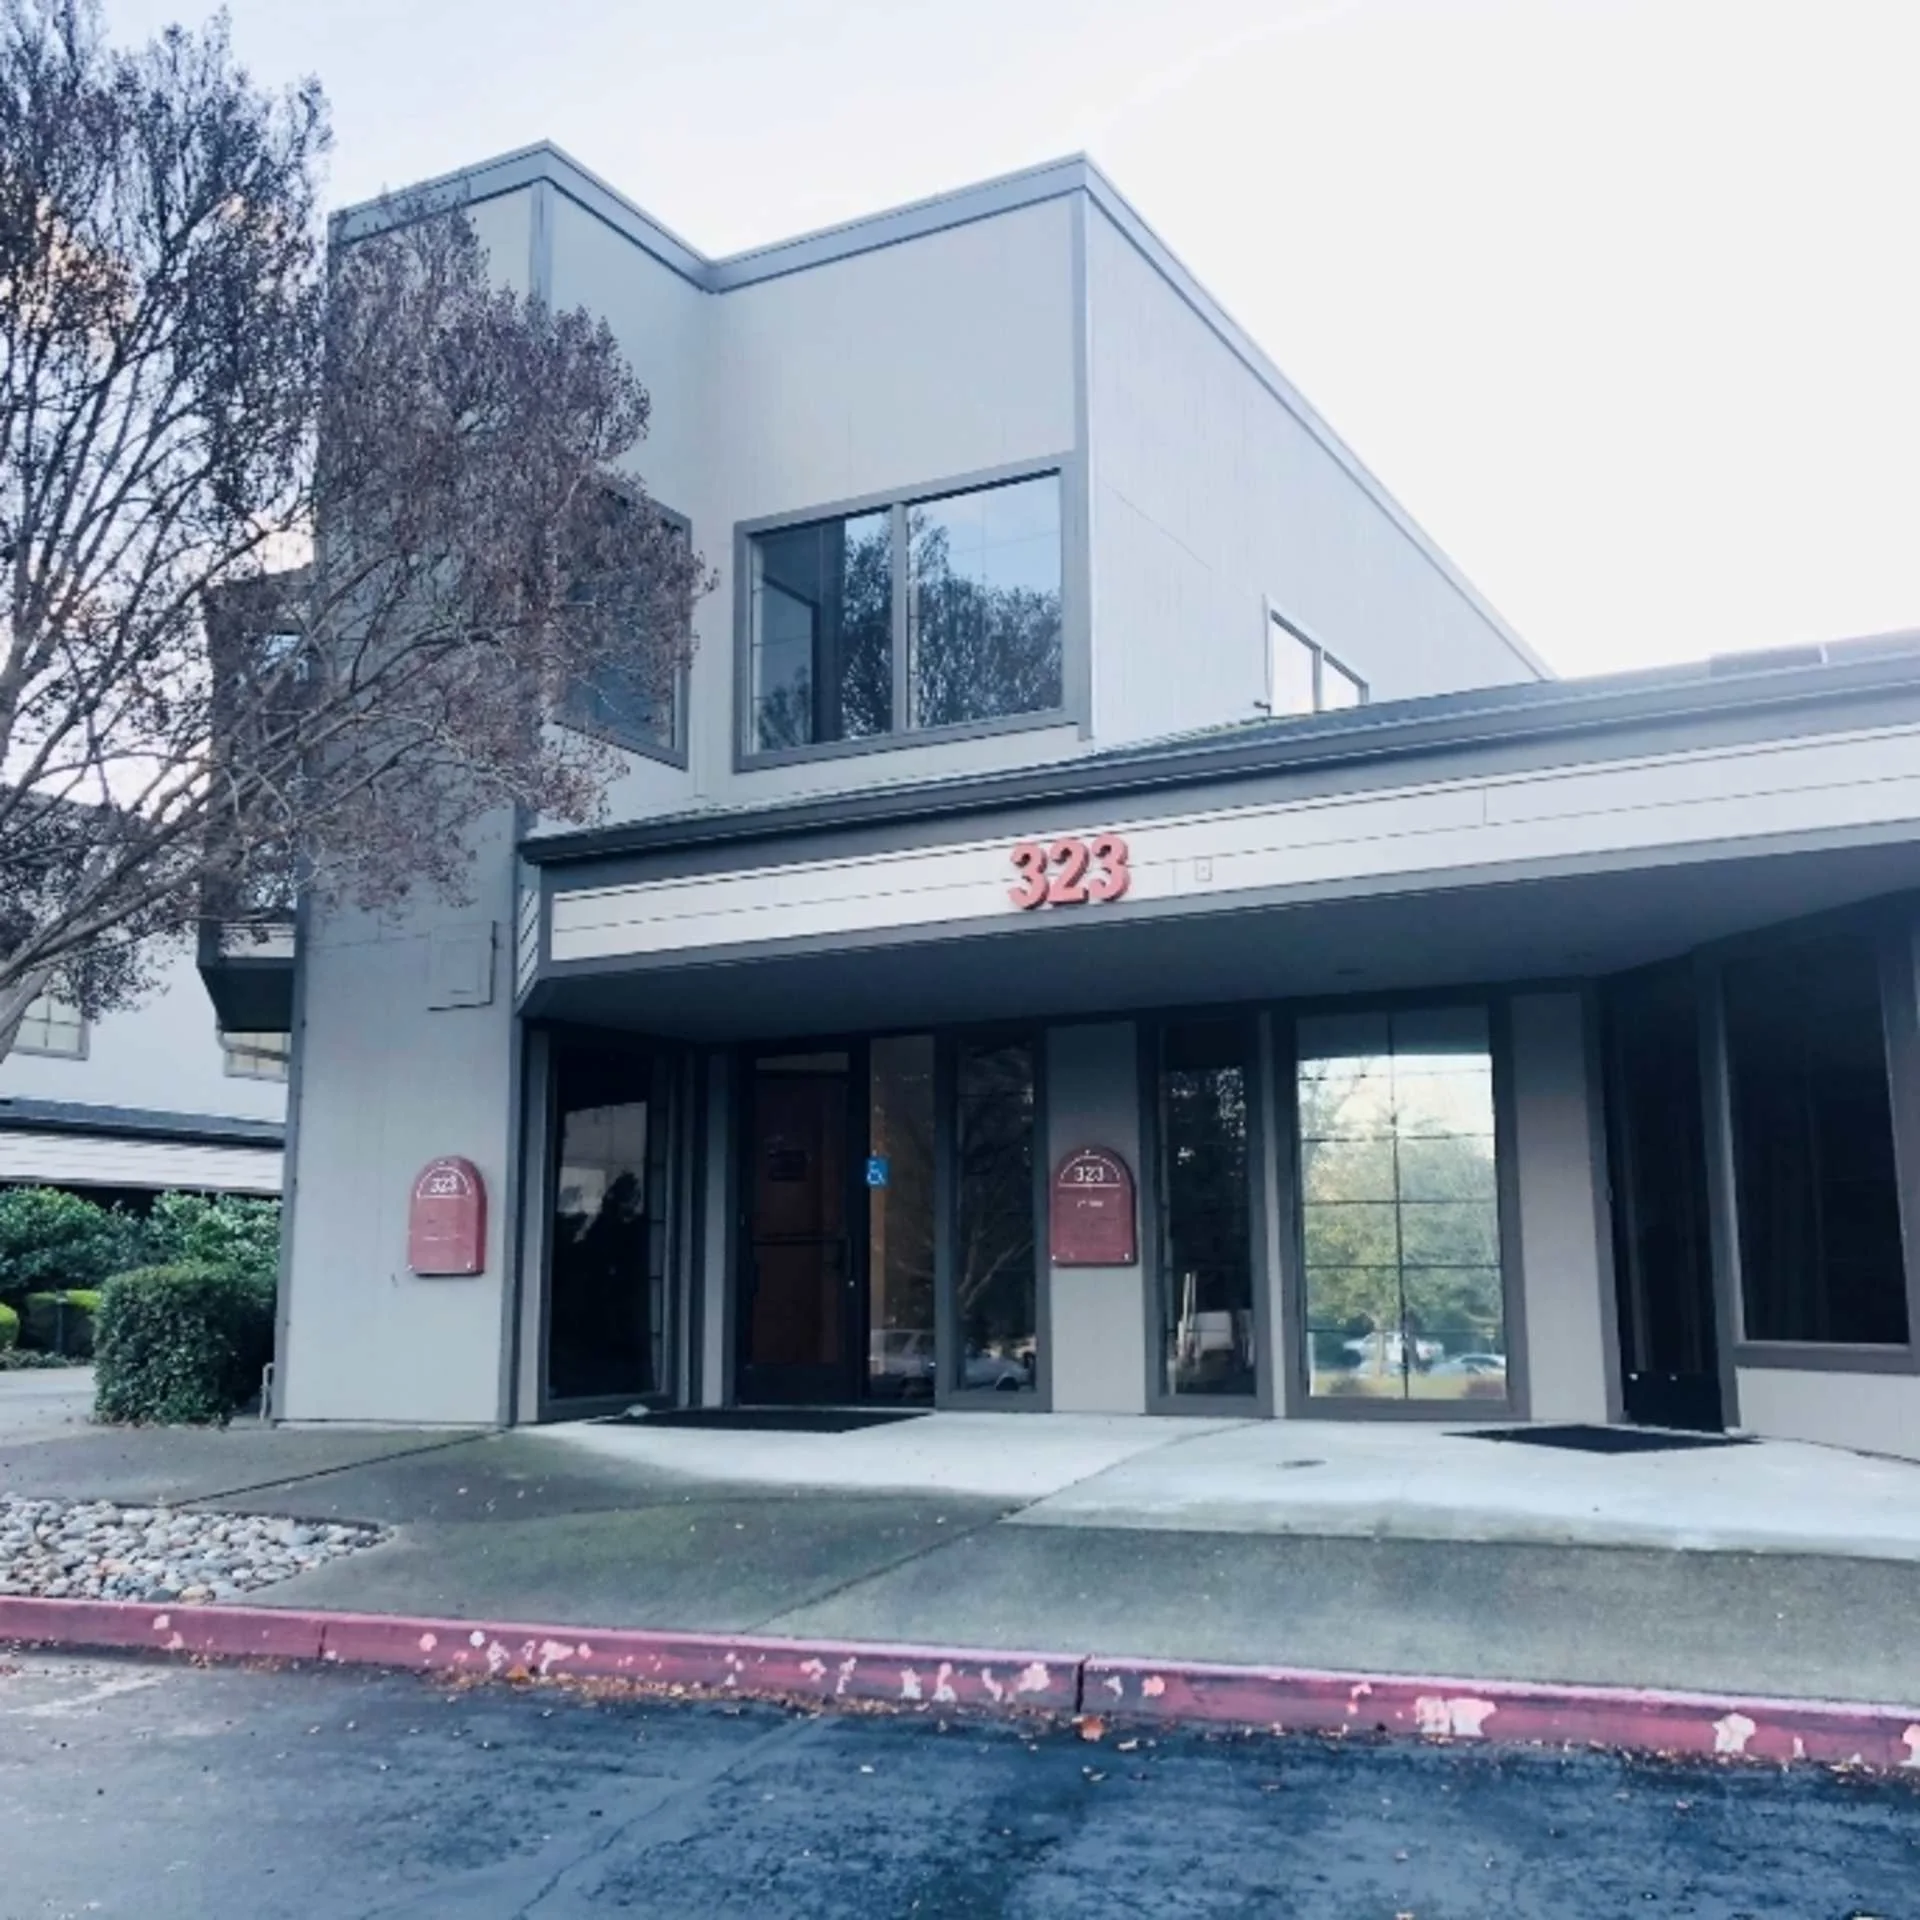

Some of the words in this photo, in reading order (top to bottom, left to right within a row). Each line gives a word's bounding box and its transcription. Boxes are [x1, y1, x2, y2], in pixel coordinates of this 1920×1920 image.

[1008, 834, 1130, 909] 323
[1074, 1166, 1104, 1182] 323
[430, 1175, 457, 1193] 323
